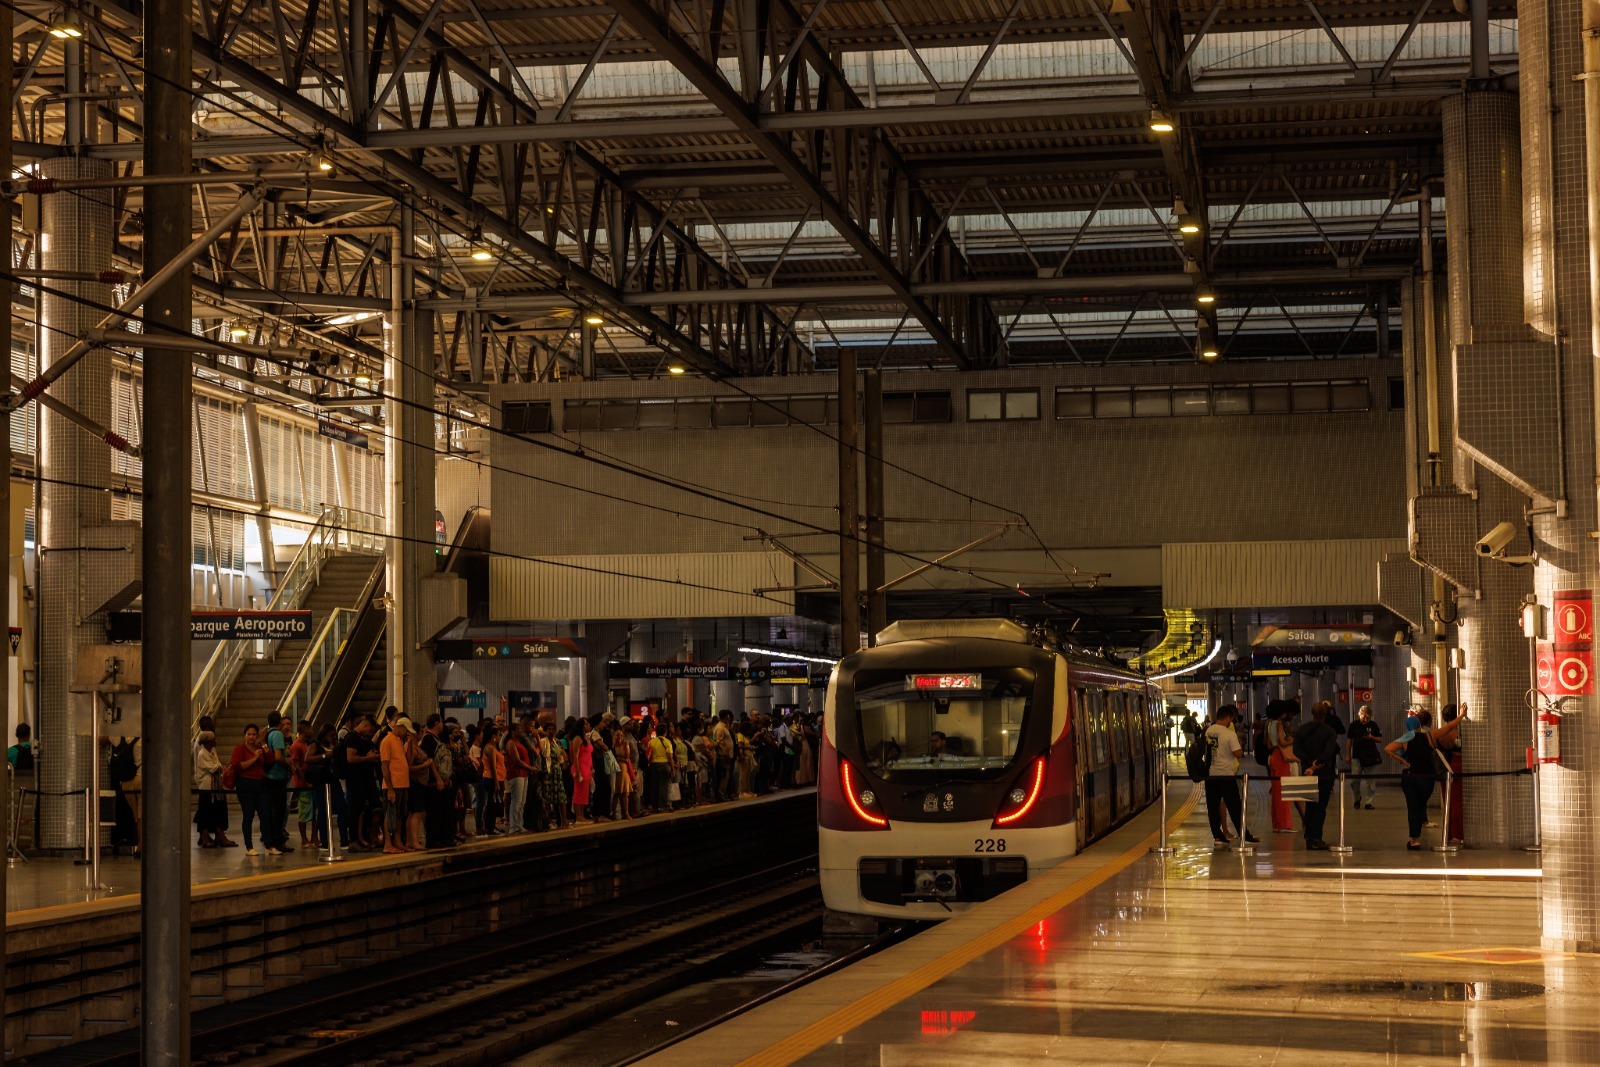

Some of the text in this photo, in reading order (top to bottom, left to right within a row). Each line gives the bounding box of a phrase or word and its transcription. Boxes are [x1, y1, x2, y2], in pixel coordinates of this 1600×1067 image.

[234, 616, 305, 633] Aeroporto
[1288, 630, 1315, 641] Saída
[523, 643, 549, 653] Saída
[1271, 654, 1329, 664] Acesso Norte
[645, 665, 725, 675] Embarque Aeroporto
[974, 838, 1006, 853] 228
